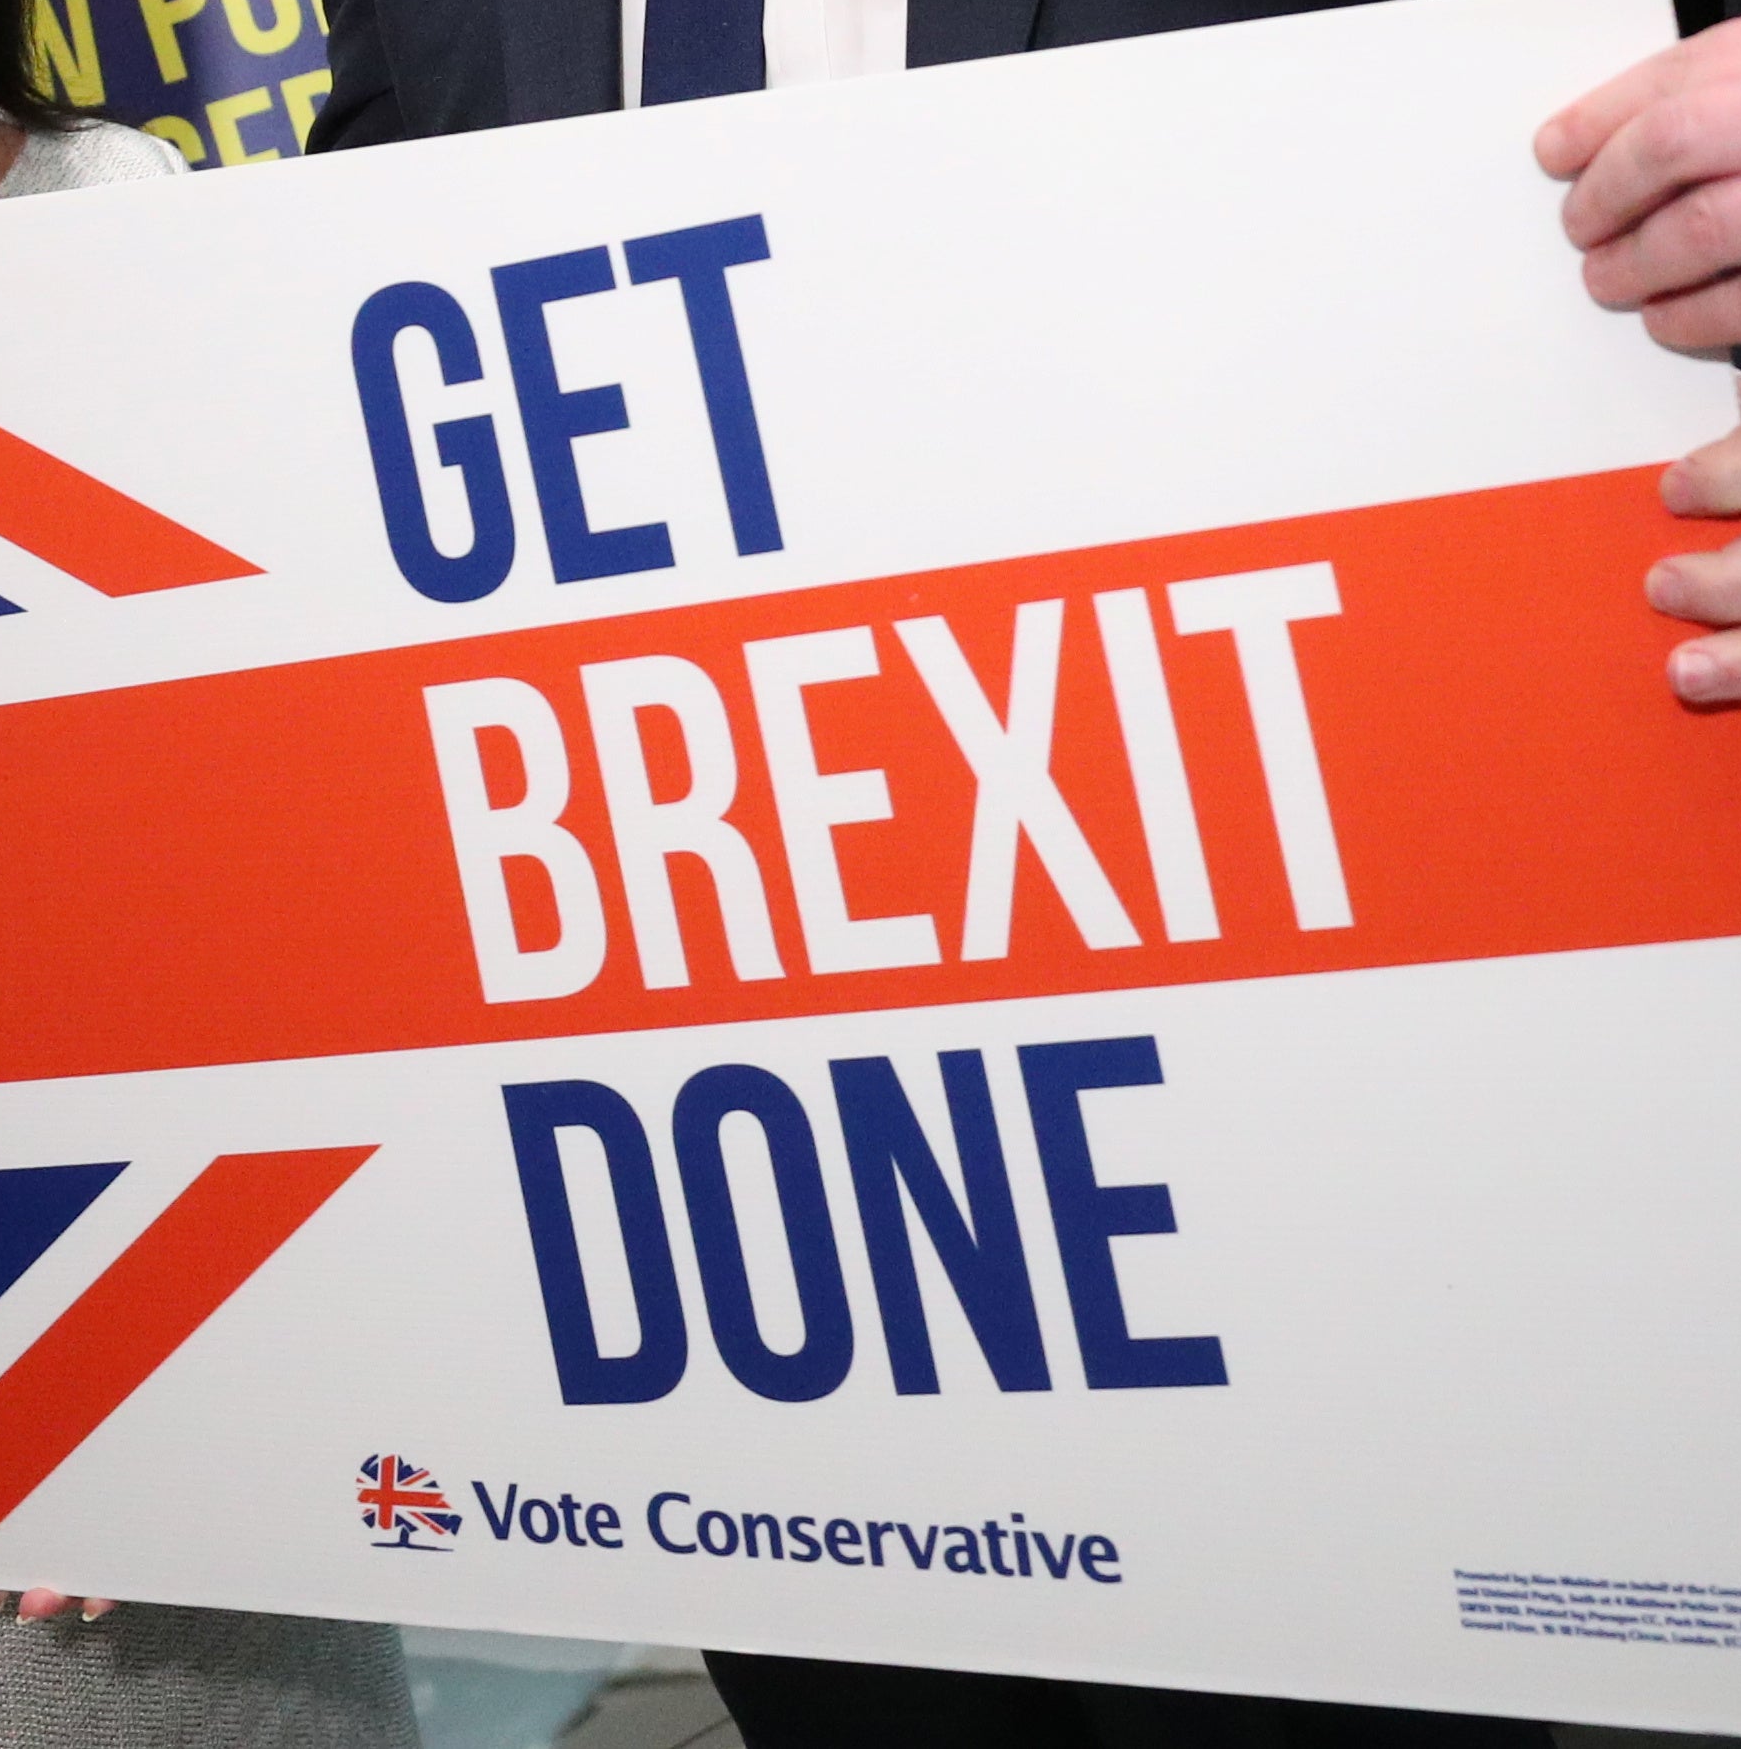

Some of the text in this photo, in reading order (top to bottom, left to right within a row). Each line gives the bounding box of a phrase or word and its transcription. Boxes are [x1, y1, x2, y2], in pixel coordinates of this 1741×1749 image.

[350, 213, 785, 604] GET
[424, 561, 1354, 1004] BREXIT
[500, 1034, 1231, 1406] DONE
[471, 1480, 1123, 1584] Vote Conservative
